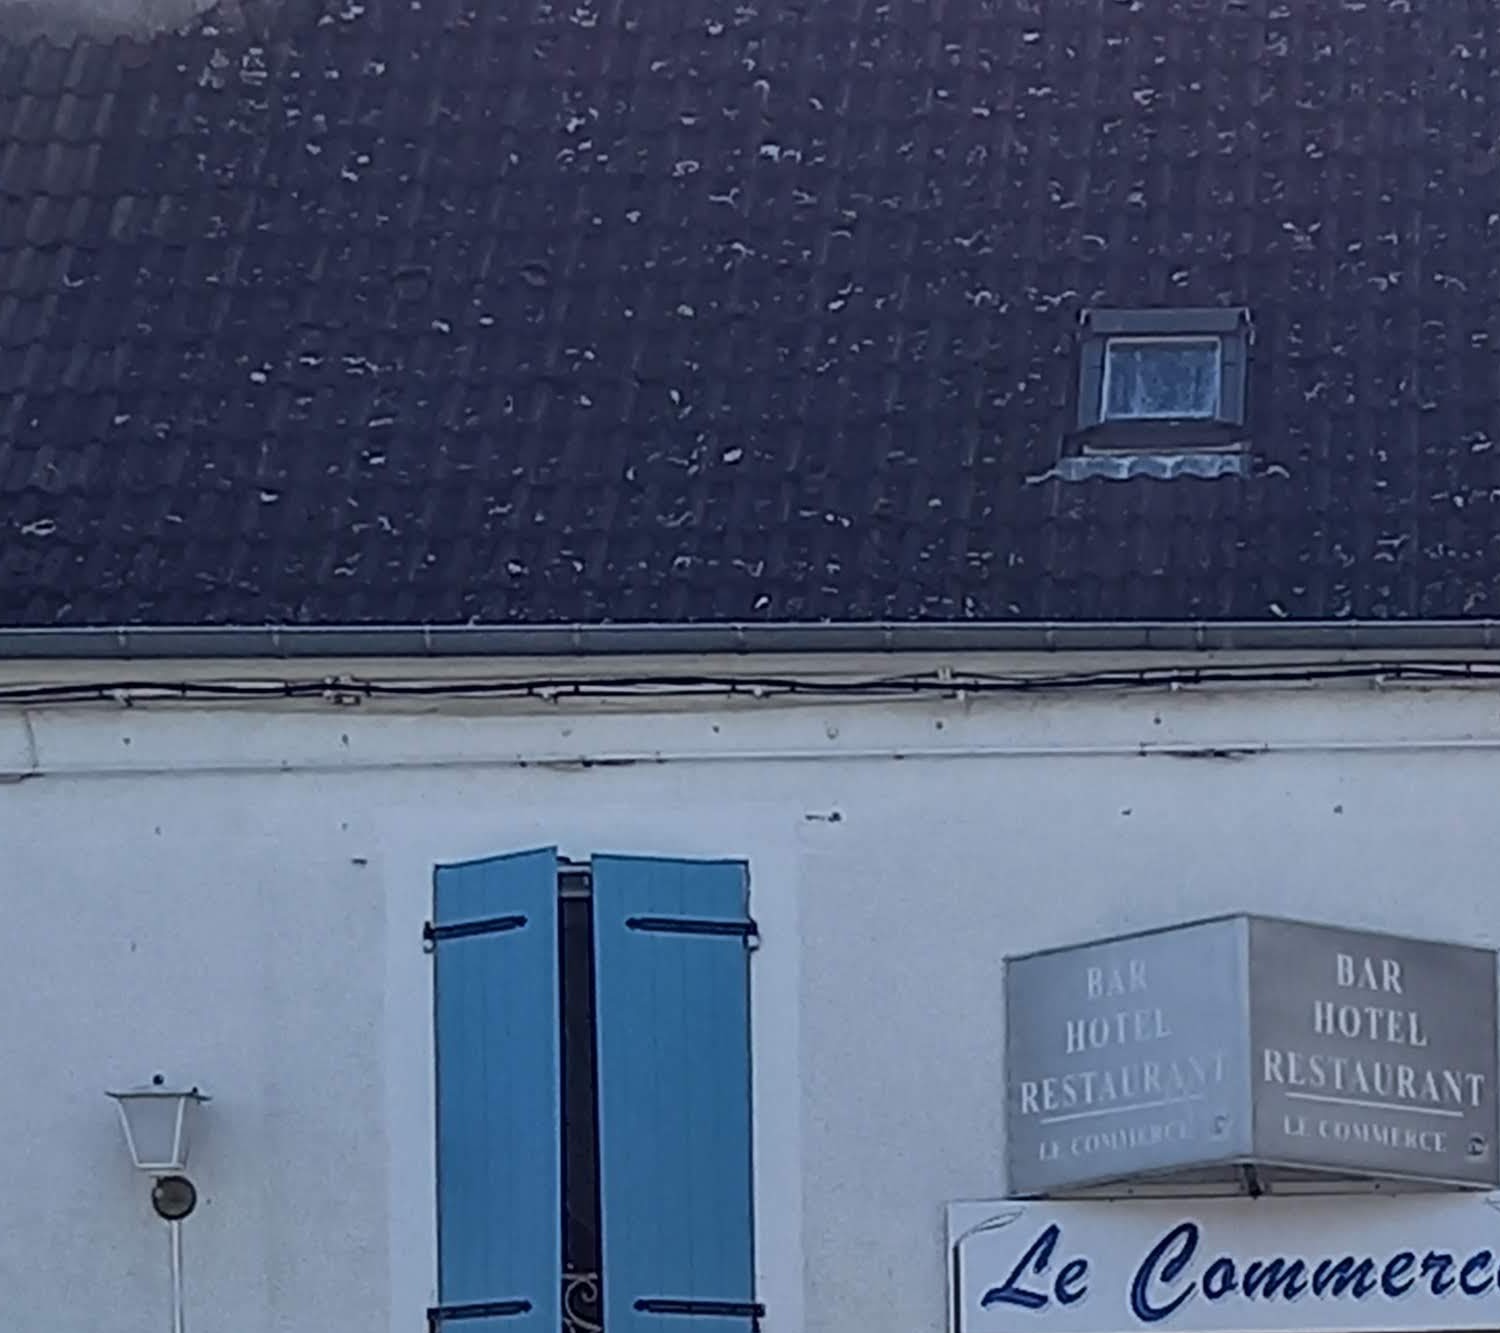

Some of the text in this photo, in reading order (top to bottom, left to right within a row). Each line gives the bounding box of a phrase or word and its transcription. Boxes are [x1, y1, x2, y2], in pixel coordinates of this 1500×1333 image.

[1086, 960, 1148, 999] BAR
[1335, 952, 1402, 995] BAR
[1065, 1008, 1173, 1054] HOTEL
[1313, 1001, 1428, 1047] HOTEL
[1020, 1046, 1229, 1115] RESTAURANT
[1262, 1048, 1486, 1108] RESTAURANT
[1038, 1116, 1194, 1162] LE COMMERCE
[1283, 1114, 1448, 1154] LE COMMERCE
[981, 1223, 1088, 1309] Le
